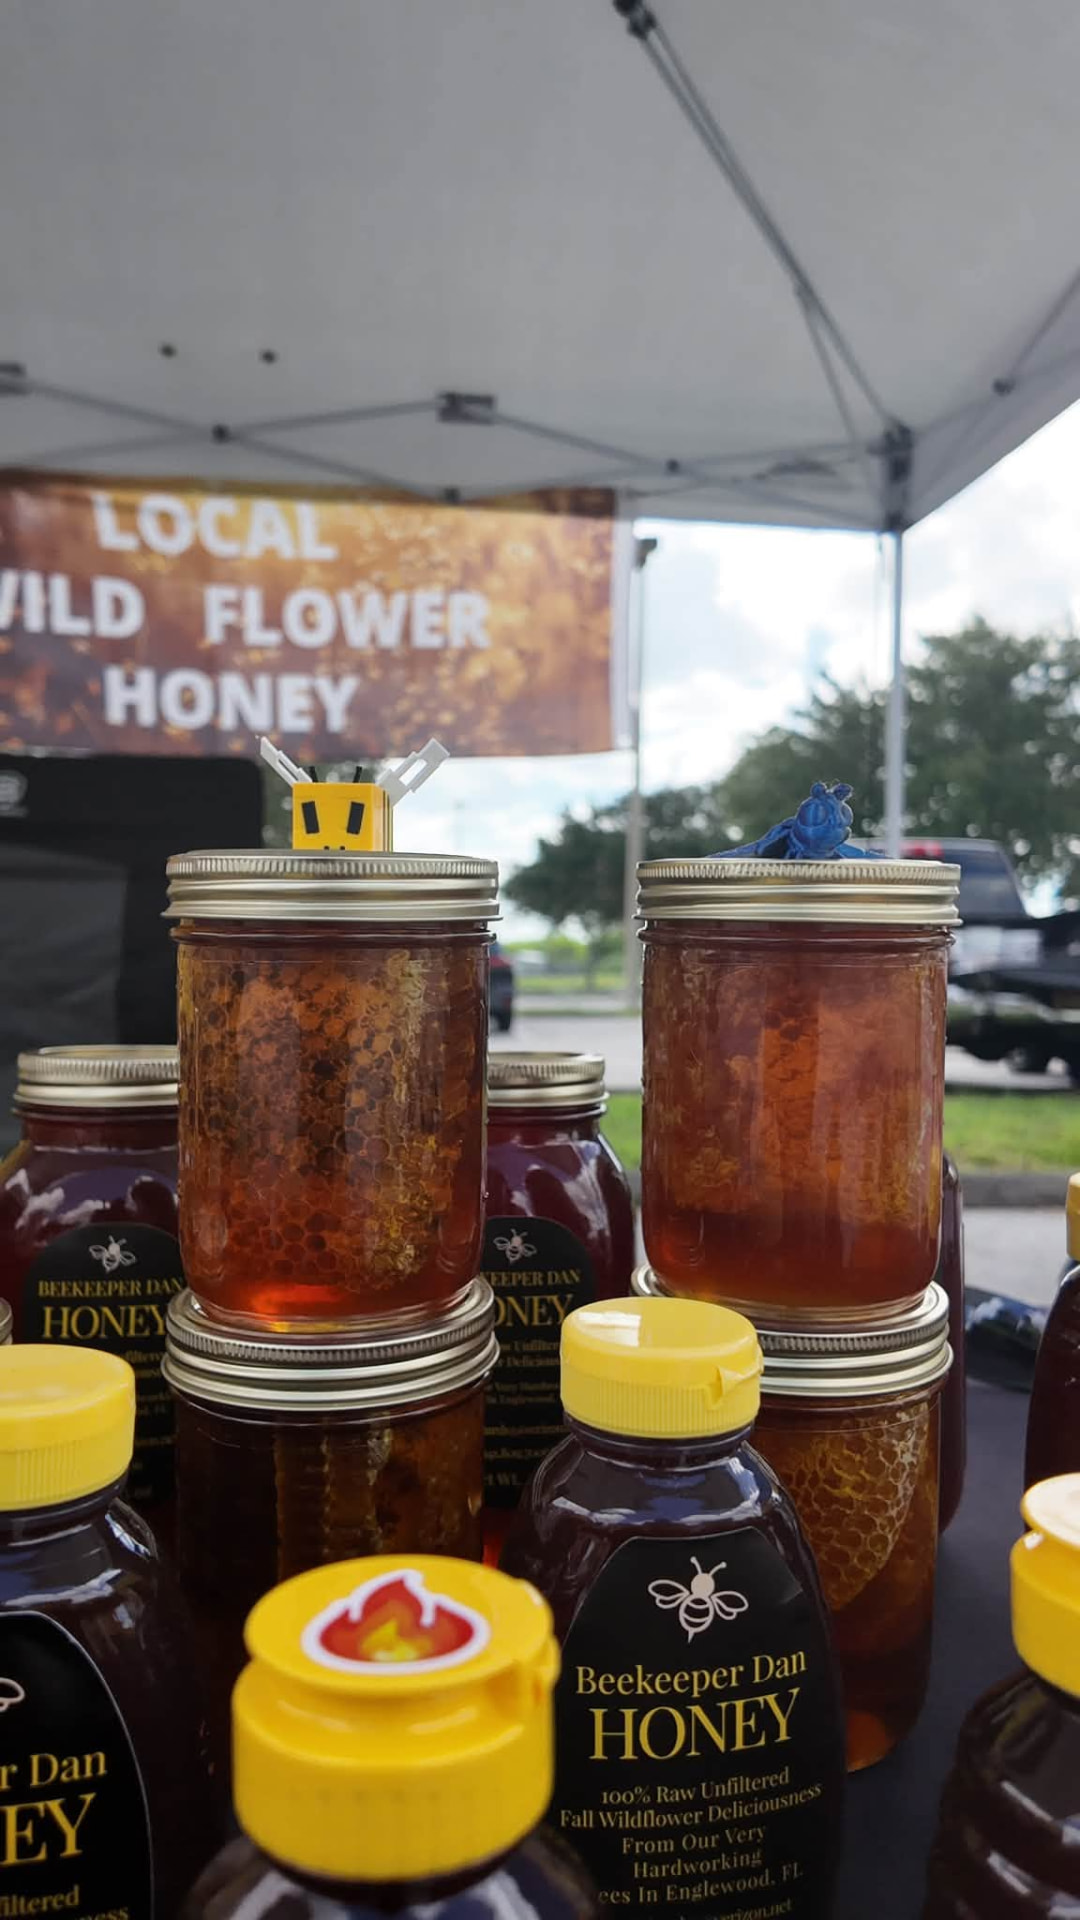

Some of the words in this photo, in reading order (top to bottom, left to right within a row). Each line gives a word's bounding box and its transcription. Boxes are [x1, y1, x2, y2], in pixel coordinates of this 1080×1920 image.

[93, 493, 339, 561] LOCAL
[204, 585, 491, 650] FLOWER
[103, 664, 361, 734] HONEY
[38, 1279, 142, 1298] BEEKEEPER
[547, 1268, 582, 1286] DAN
[42, 1304, 168, 1340] HONEY
[576, 1664, 745, 1698] Beekeeper
[752, 1650, 808, 1684] Dan
[588, 1687, 801, 1761] HONEY
[29, 1751, 108, 1788] Dan
[601, 1785, 652, 1806] 100%
[656, 1785, 697, 1804] Raw
[700, 1766, 791, 1800] Unfiltered
[560, 1809, 595, 1829] Fall
[598, 1809, 703, 1829] Wildflower
[708, 1783, 824, 1822] Deliciousness
[622, 1836, 675, 1854] From
[682, 1832, 720, 1851] Our
[725, 1825, 767, 1844] Very
[633, 1849, 763, 1880] Hardworking
[598, 1889, 632, 1906] ees
[639, 1886, 659, 1904] In
